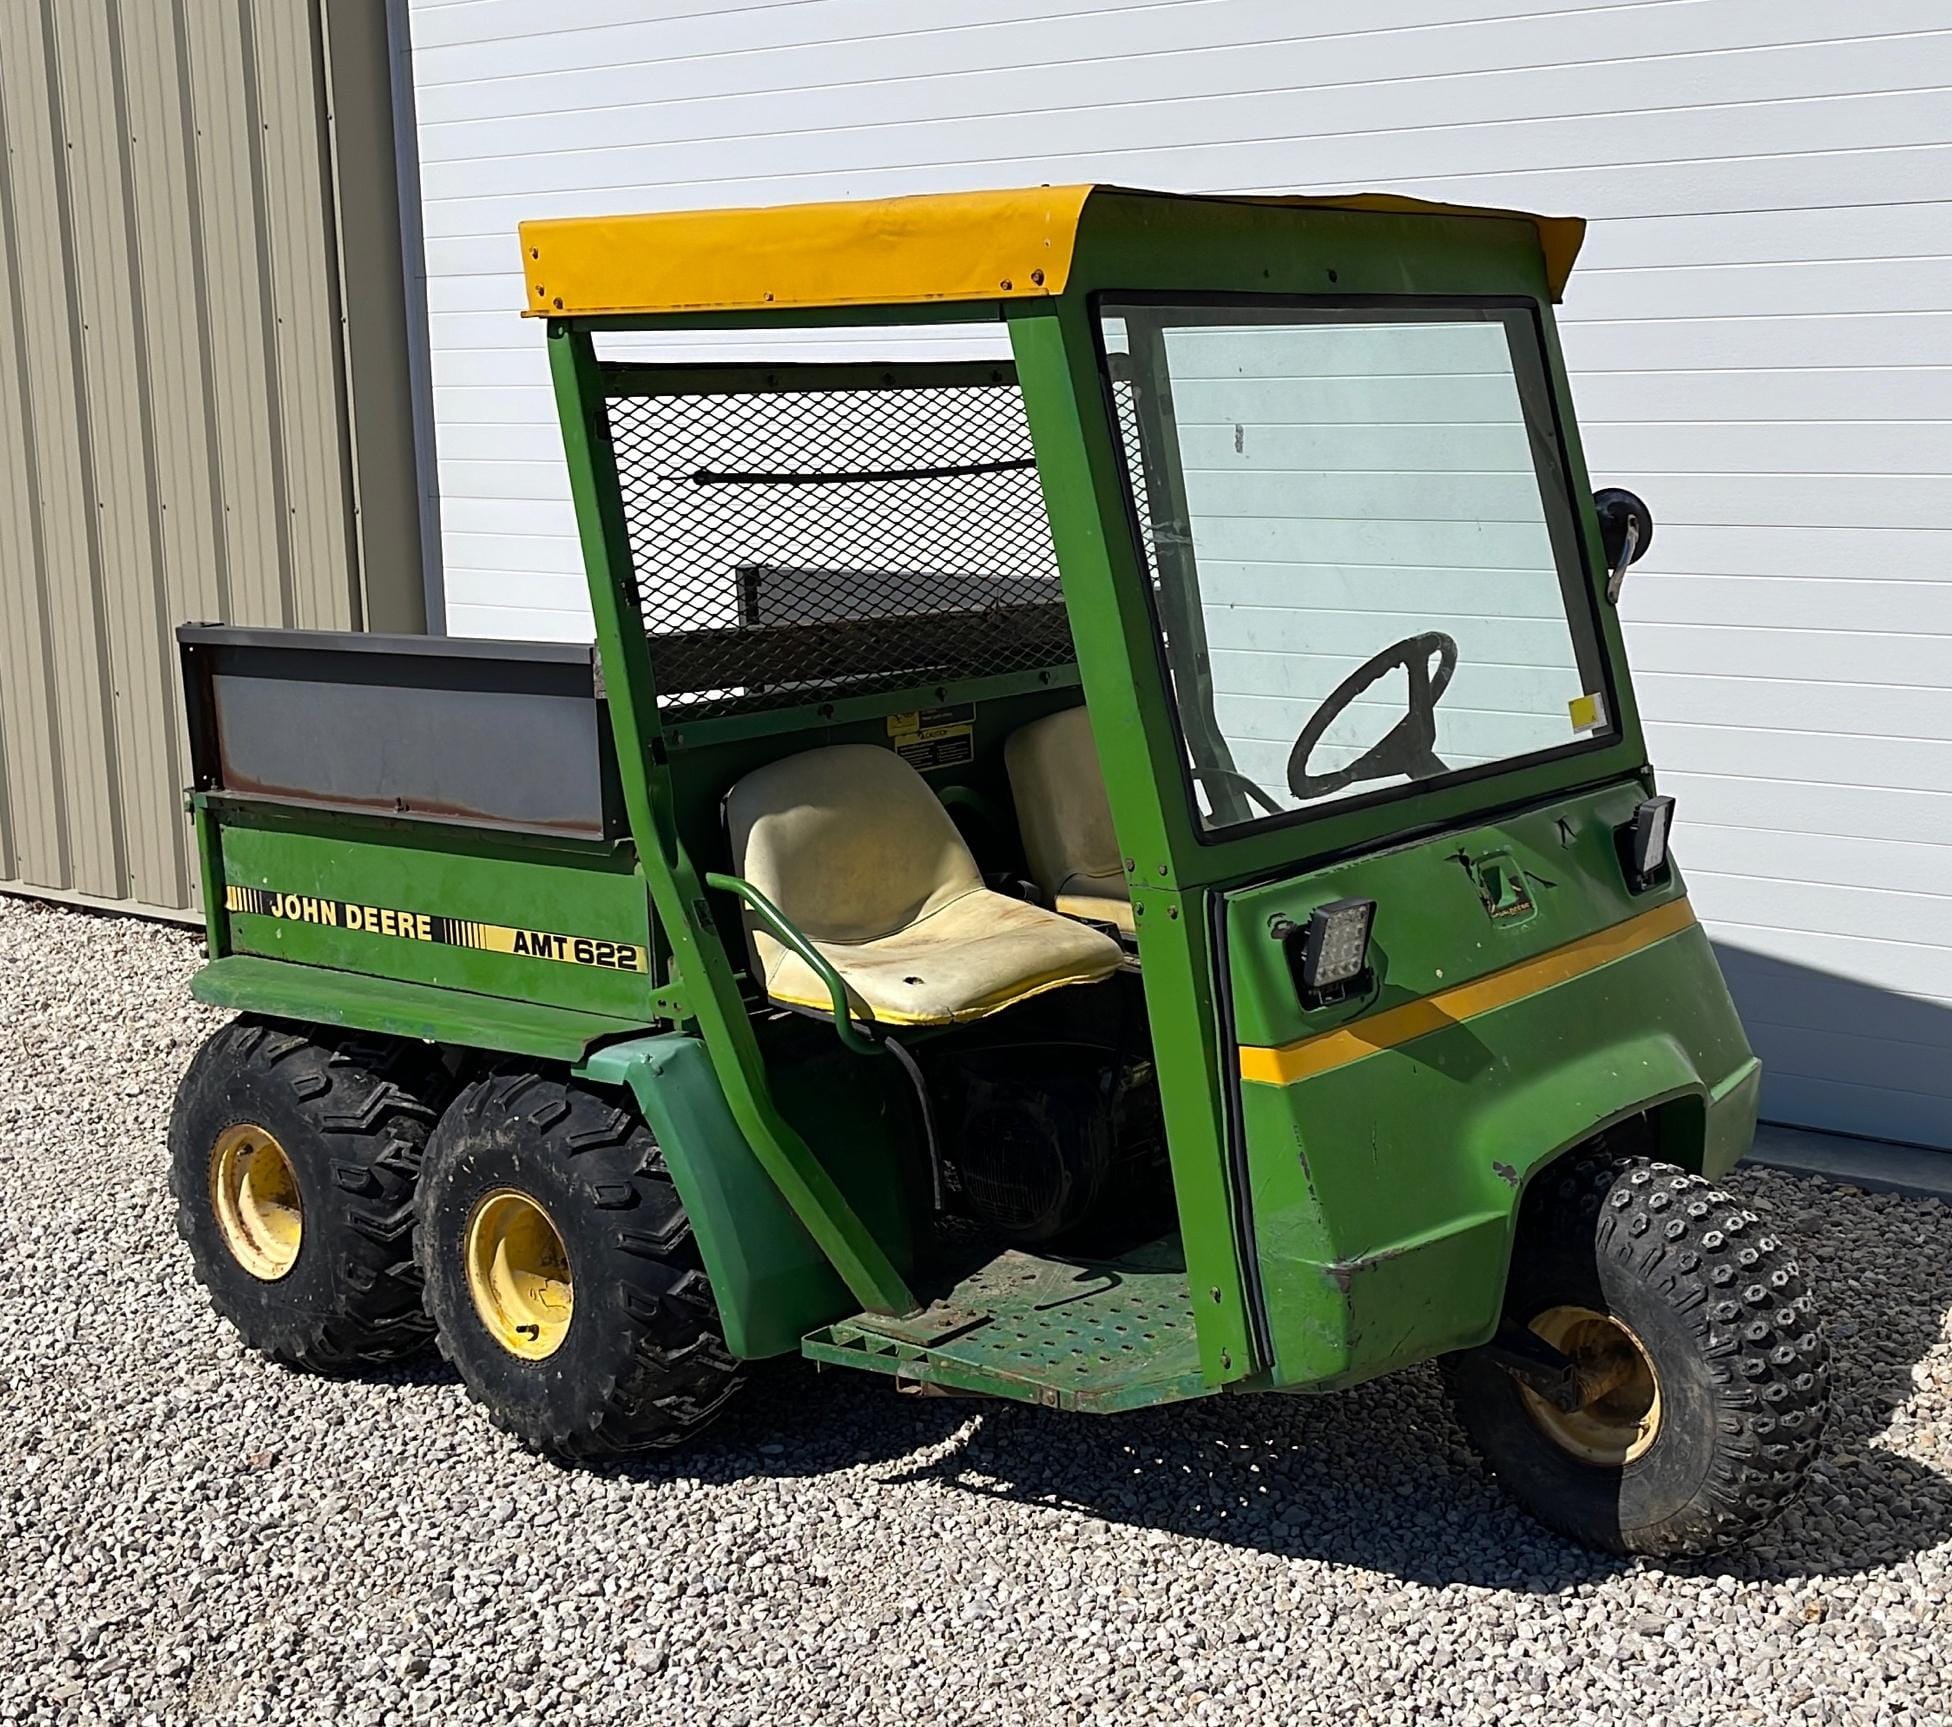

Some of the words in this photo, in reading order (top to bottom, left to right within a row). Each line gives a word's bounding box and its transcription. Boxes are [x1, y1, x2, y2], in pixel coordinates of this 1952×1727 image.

[271, 894, 337, 926] JOHN
[345, 904, 432, 941] DEERE
[512, 930, 567, 960] AMT
[574, 939, 638, 970] 622
